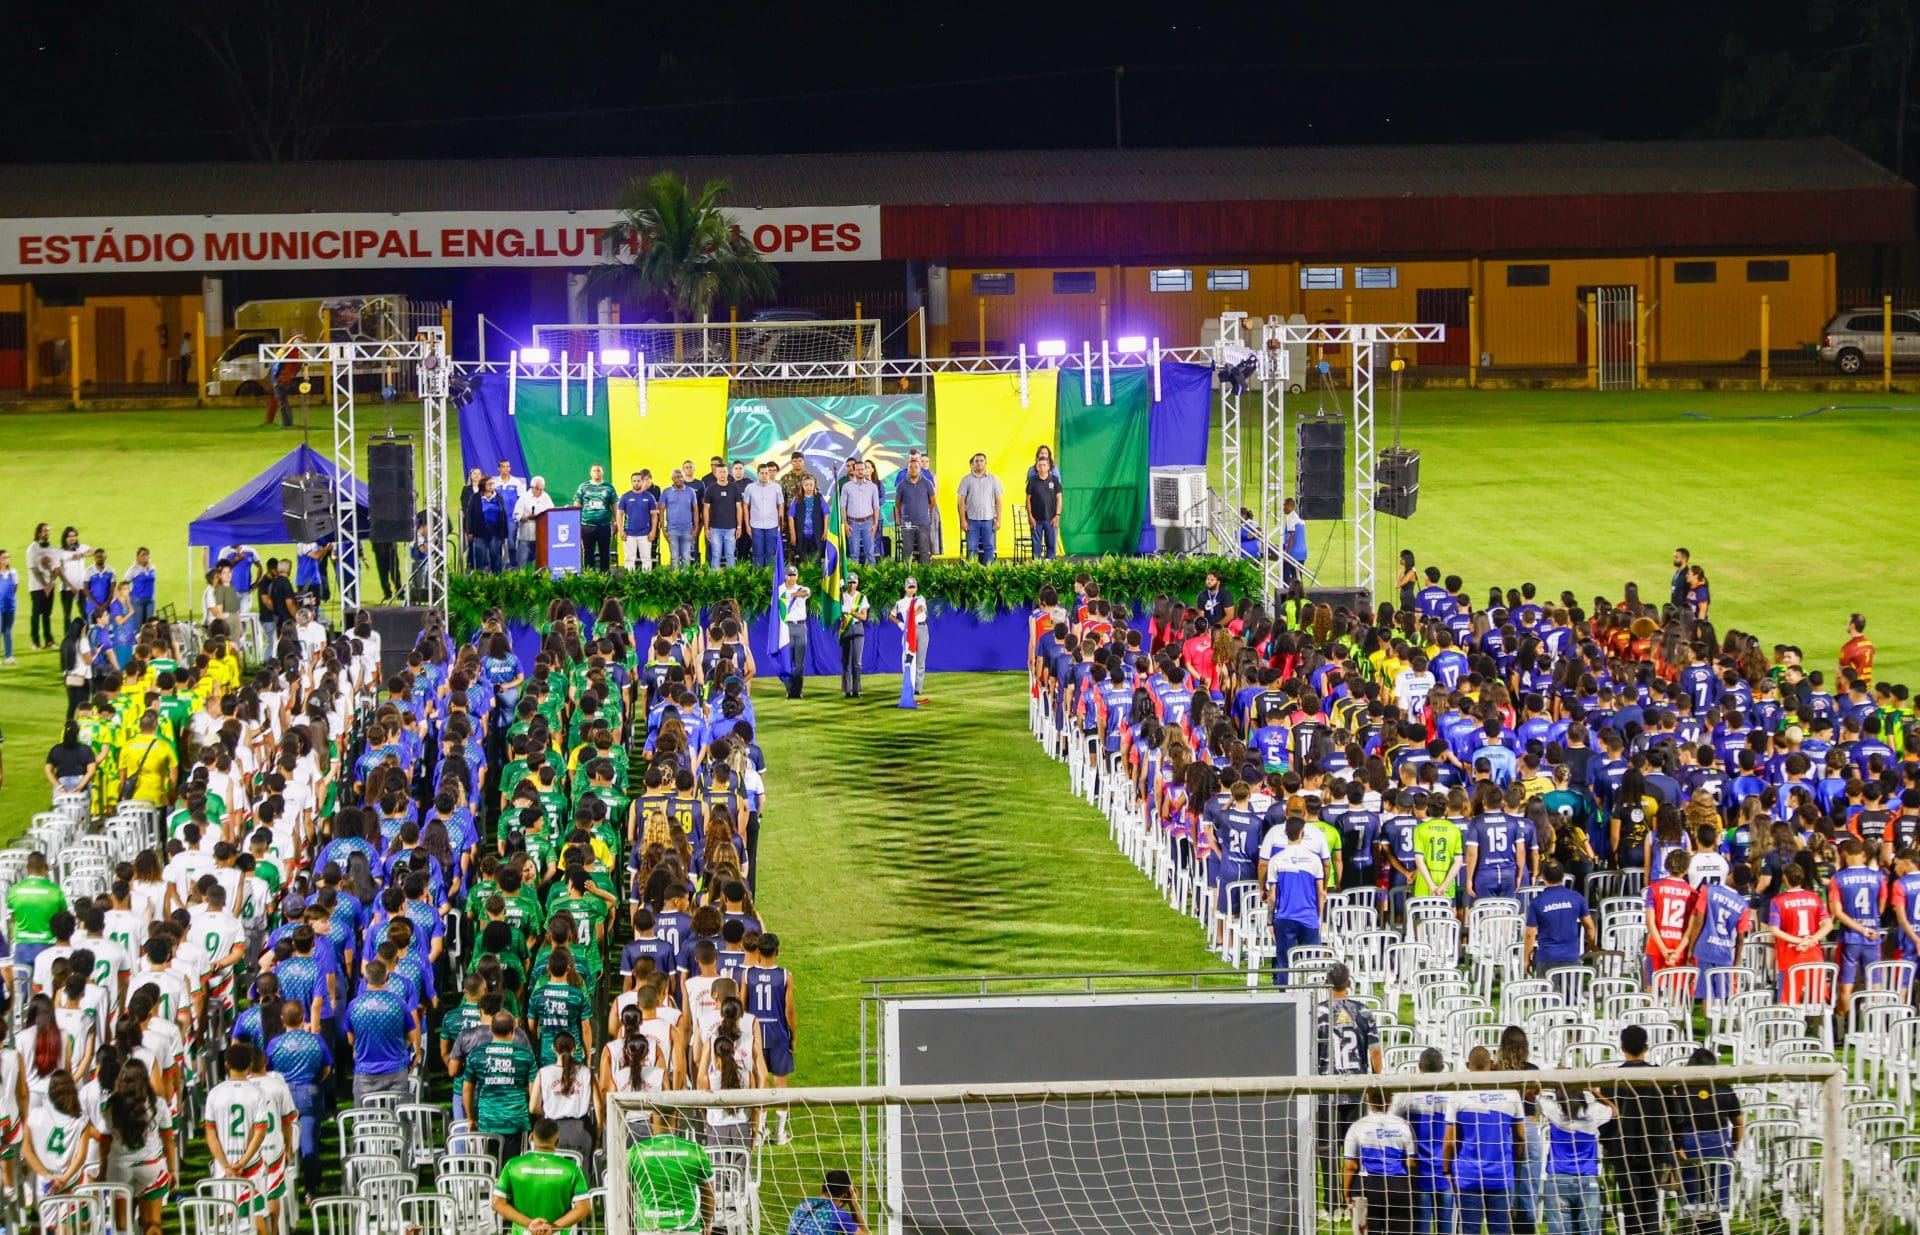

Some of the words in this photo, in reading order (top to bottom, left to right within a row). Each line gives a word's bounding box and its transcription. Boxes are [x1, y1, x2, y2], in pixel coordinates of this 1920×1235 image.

[18, 227, 194, 265] ESTÁDIO
[204, 229, 432, 261] MUNICIPAL
[733, 404, 770, 414] BRASIL
[1695, 683, 1709, 707] 7
[1267, 746, 1281, 765] 5
[1229, 829, 1248, 854] 21
[1354, 825, 1366, 850] 7
[1429, 836, 1448, 862] 12
[1486, 826, 1508, 853] 15
[1843, 874, 1878, 886] FUTSAL
[1661, 897, 1687, 929] 12
[1784, 897, 1817, 909] FUTSAL
[1854, 887, 1870, 915] 4
[658, 918, 677, 926] FUTSAL
[1717, 907, 1732, 936] 5
[1797, 909, 1810, 936] 1
[205, 932, 221, 962] 9
[640, 945, 658, 953] FUTSAL
[755, 984, 772, 1012] 11
[485, 1046, 514, 1055] COMISSÃO
[1333, 1026, 1359, 1071] 12
[494, 1058, 512, 1068] R10
[230, 1103, 246, 1138] 2
[46, 1126, 66, 1157] 4
